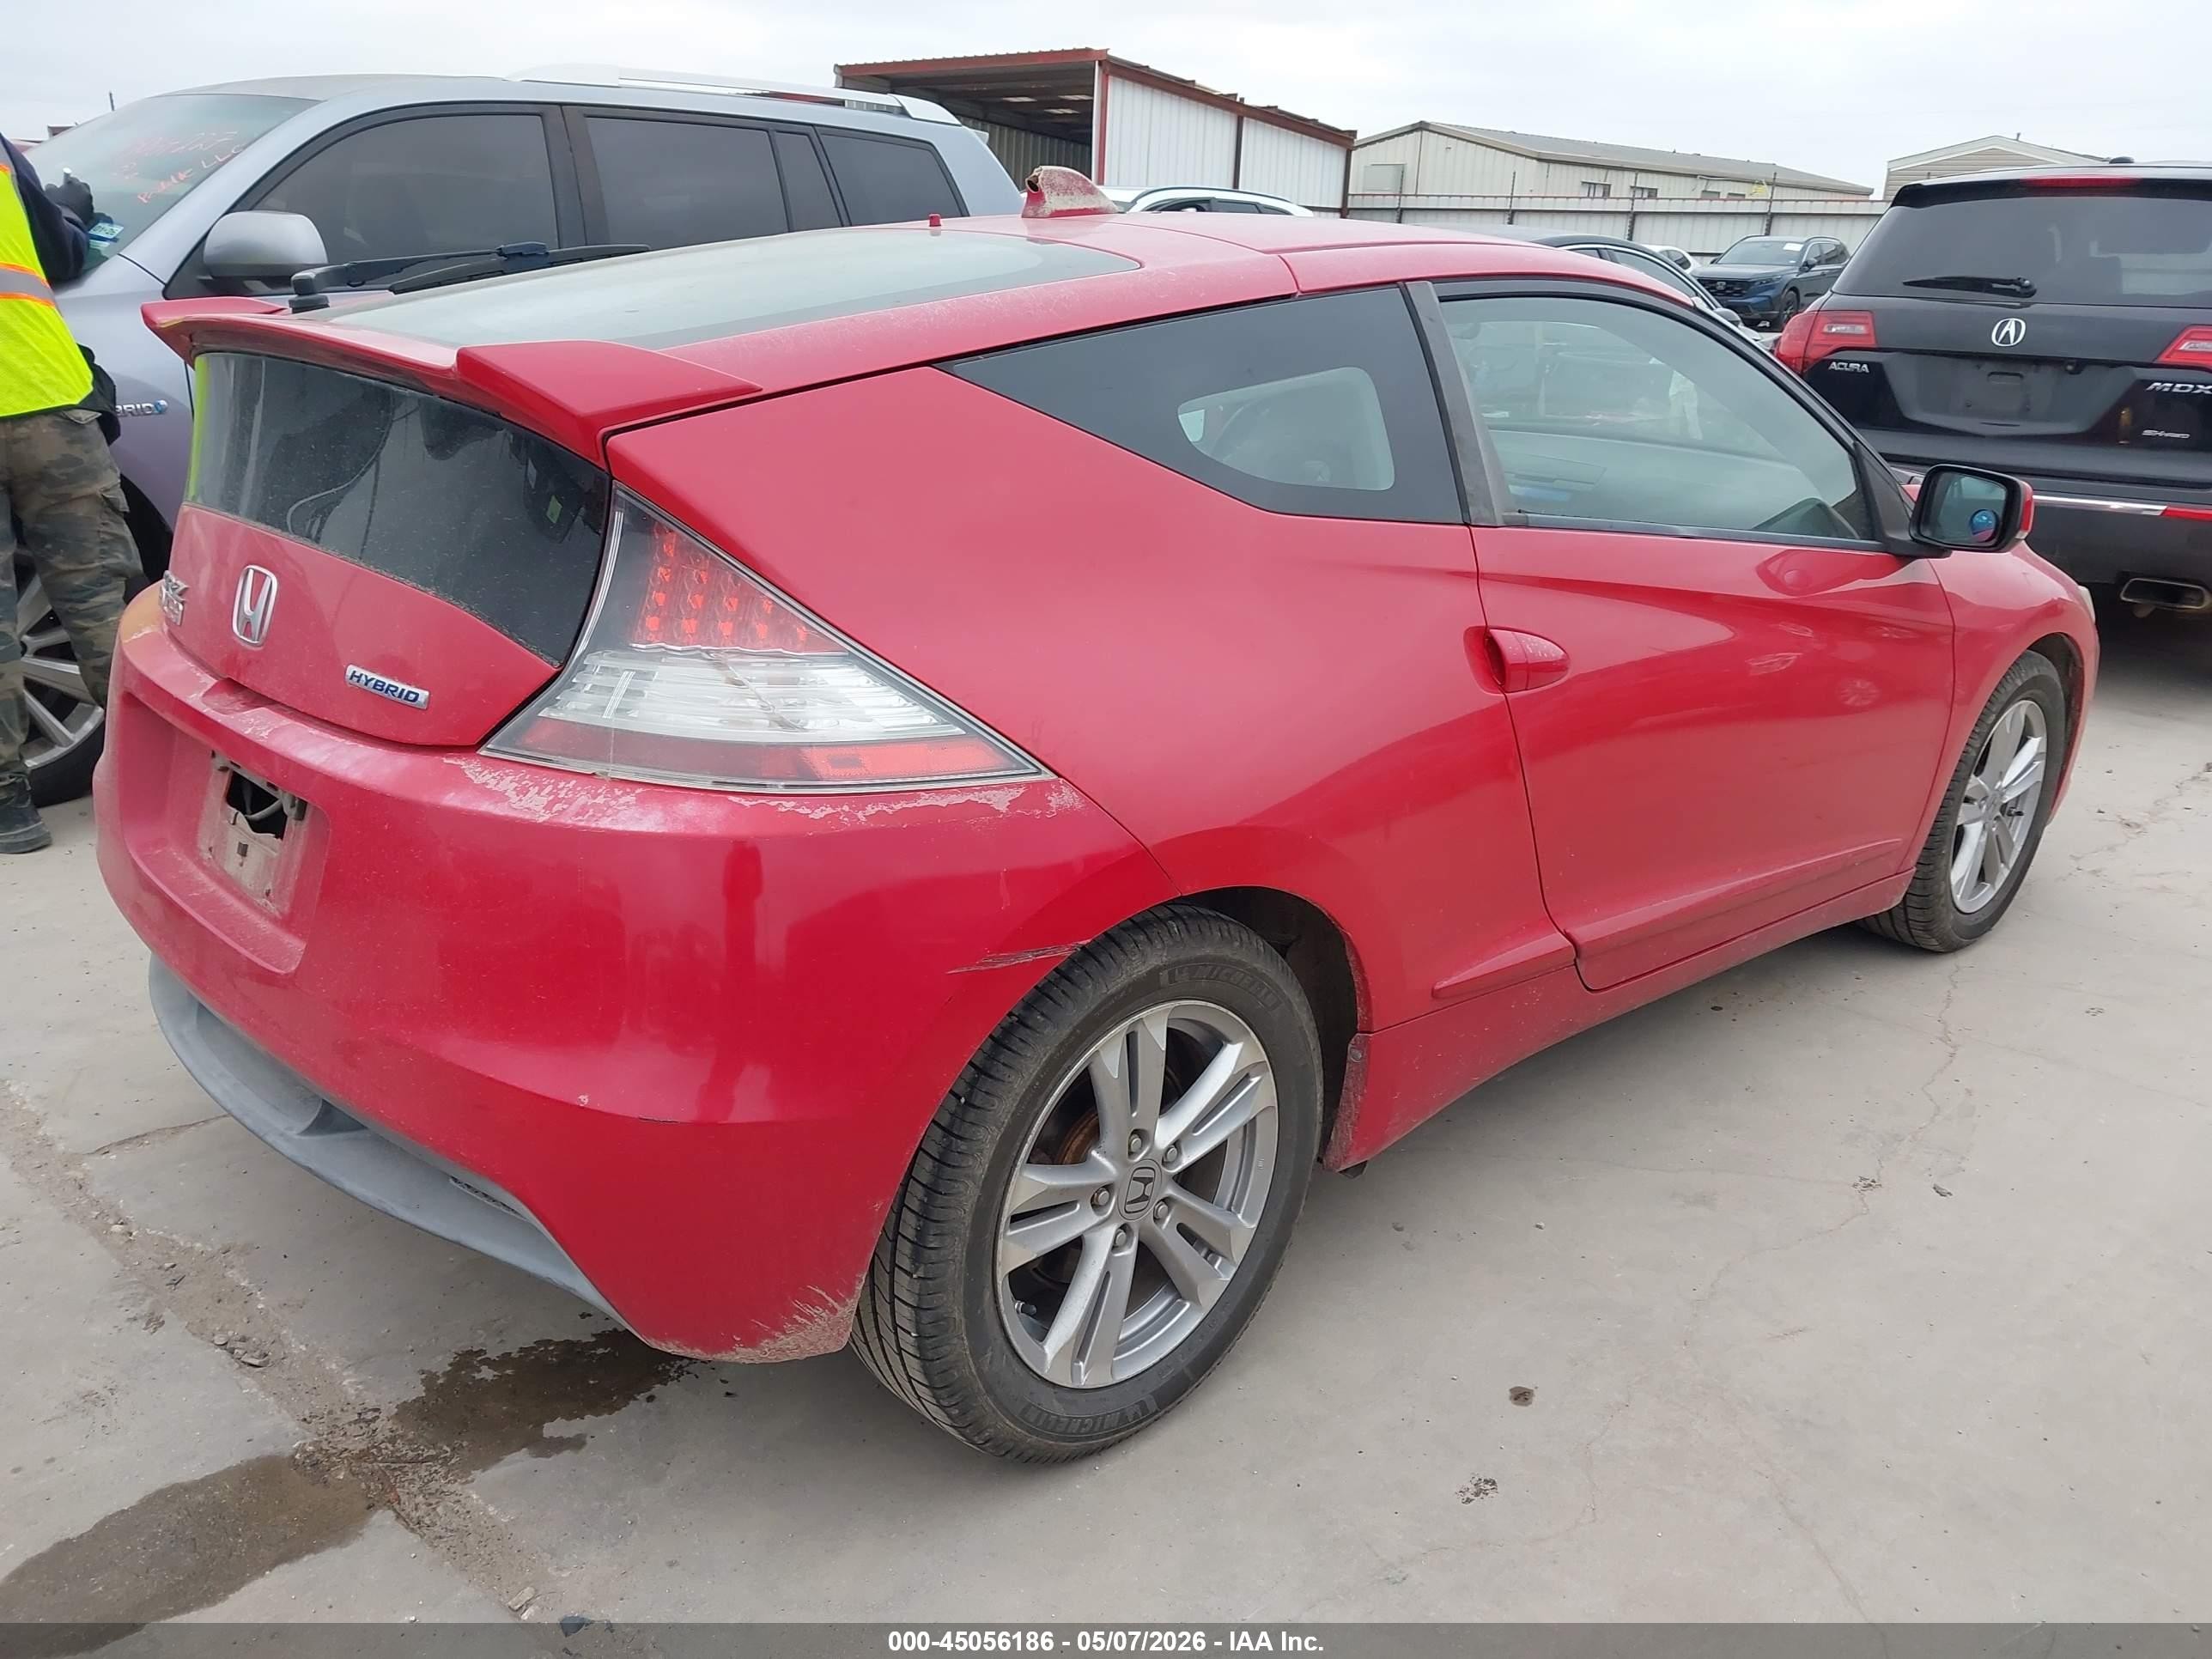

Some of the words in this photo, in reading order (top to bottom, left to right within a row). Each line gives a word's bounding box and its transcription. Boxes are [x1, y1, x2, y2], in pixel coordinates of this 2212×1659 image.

[1828, 362, 1869, 373] ACURA
[2146, 382, 2212, 394] MDX
[115, 403, 155, 416] BRID
[349, 670, 420, 703] HYBRID
